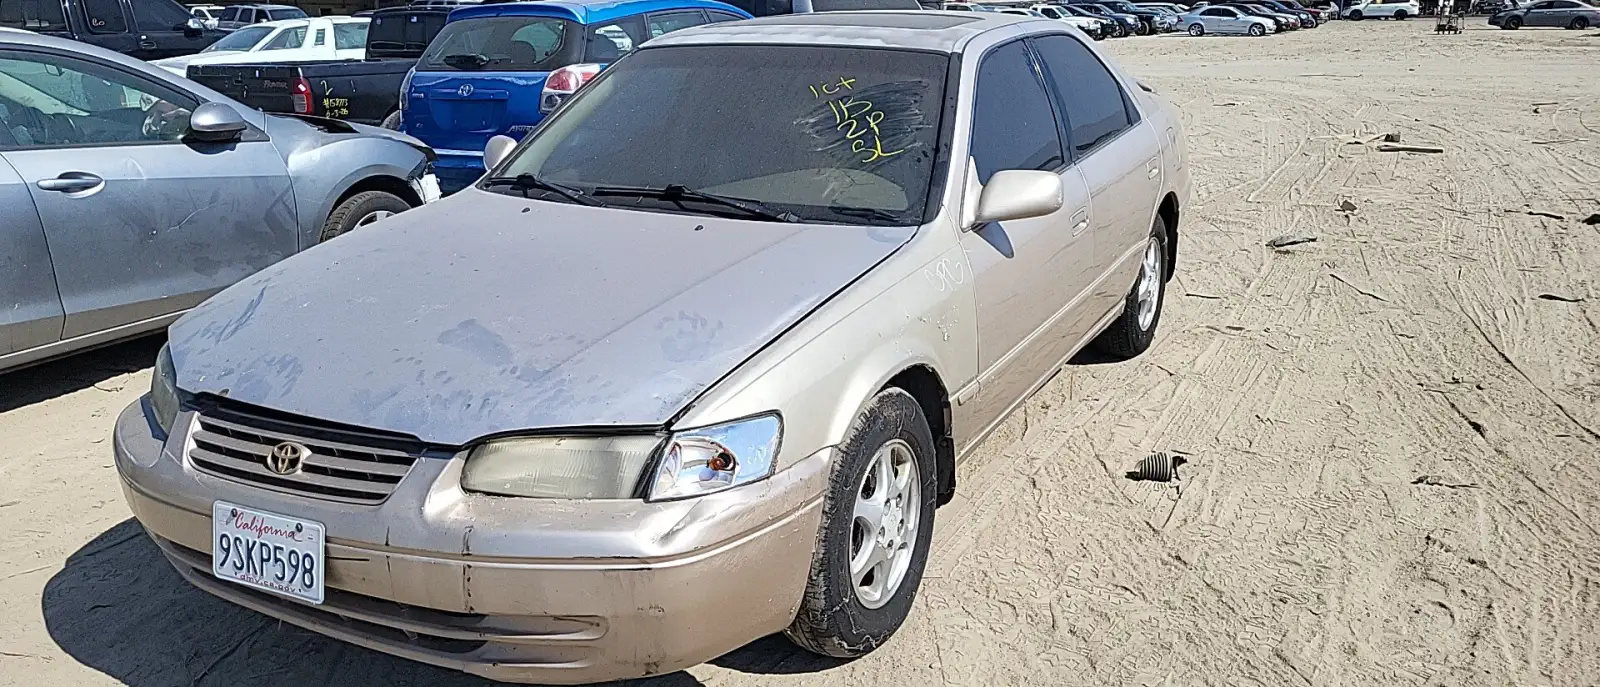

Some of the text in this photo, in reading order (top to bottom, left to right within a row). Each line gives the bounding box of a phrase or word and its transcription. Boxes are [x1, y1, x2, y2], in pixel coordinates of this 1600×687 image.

[234, 511, 303, 543] California
[219, 532, 315, 590] 9SKP598
[240, 573, 297, 593] dmv.ca.gov
